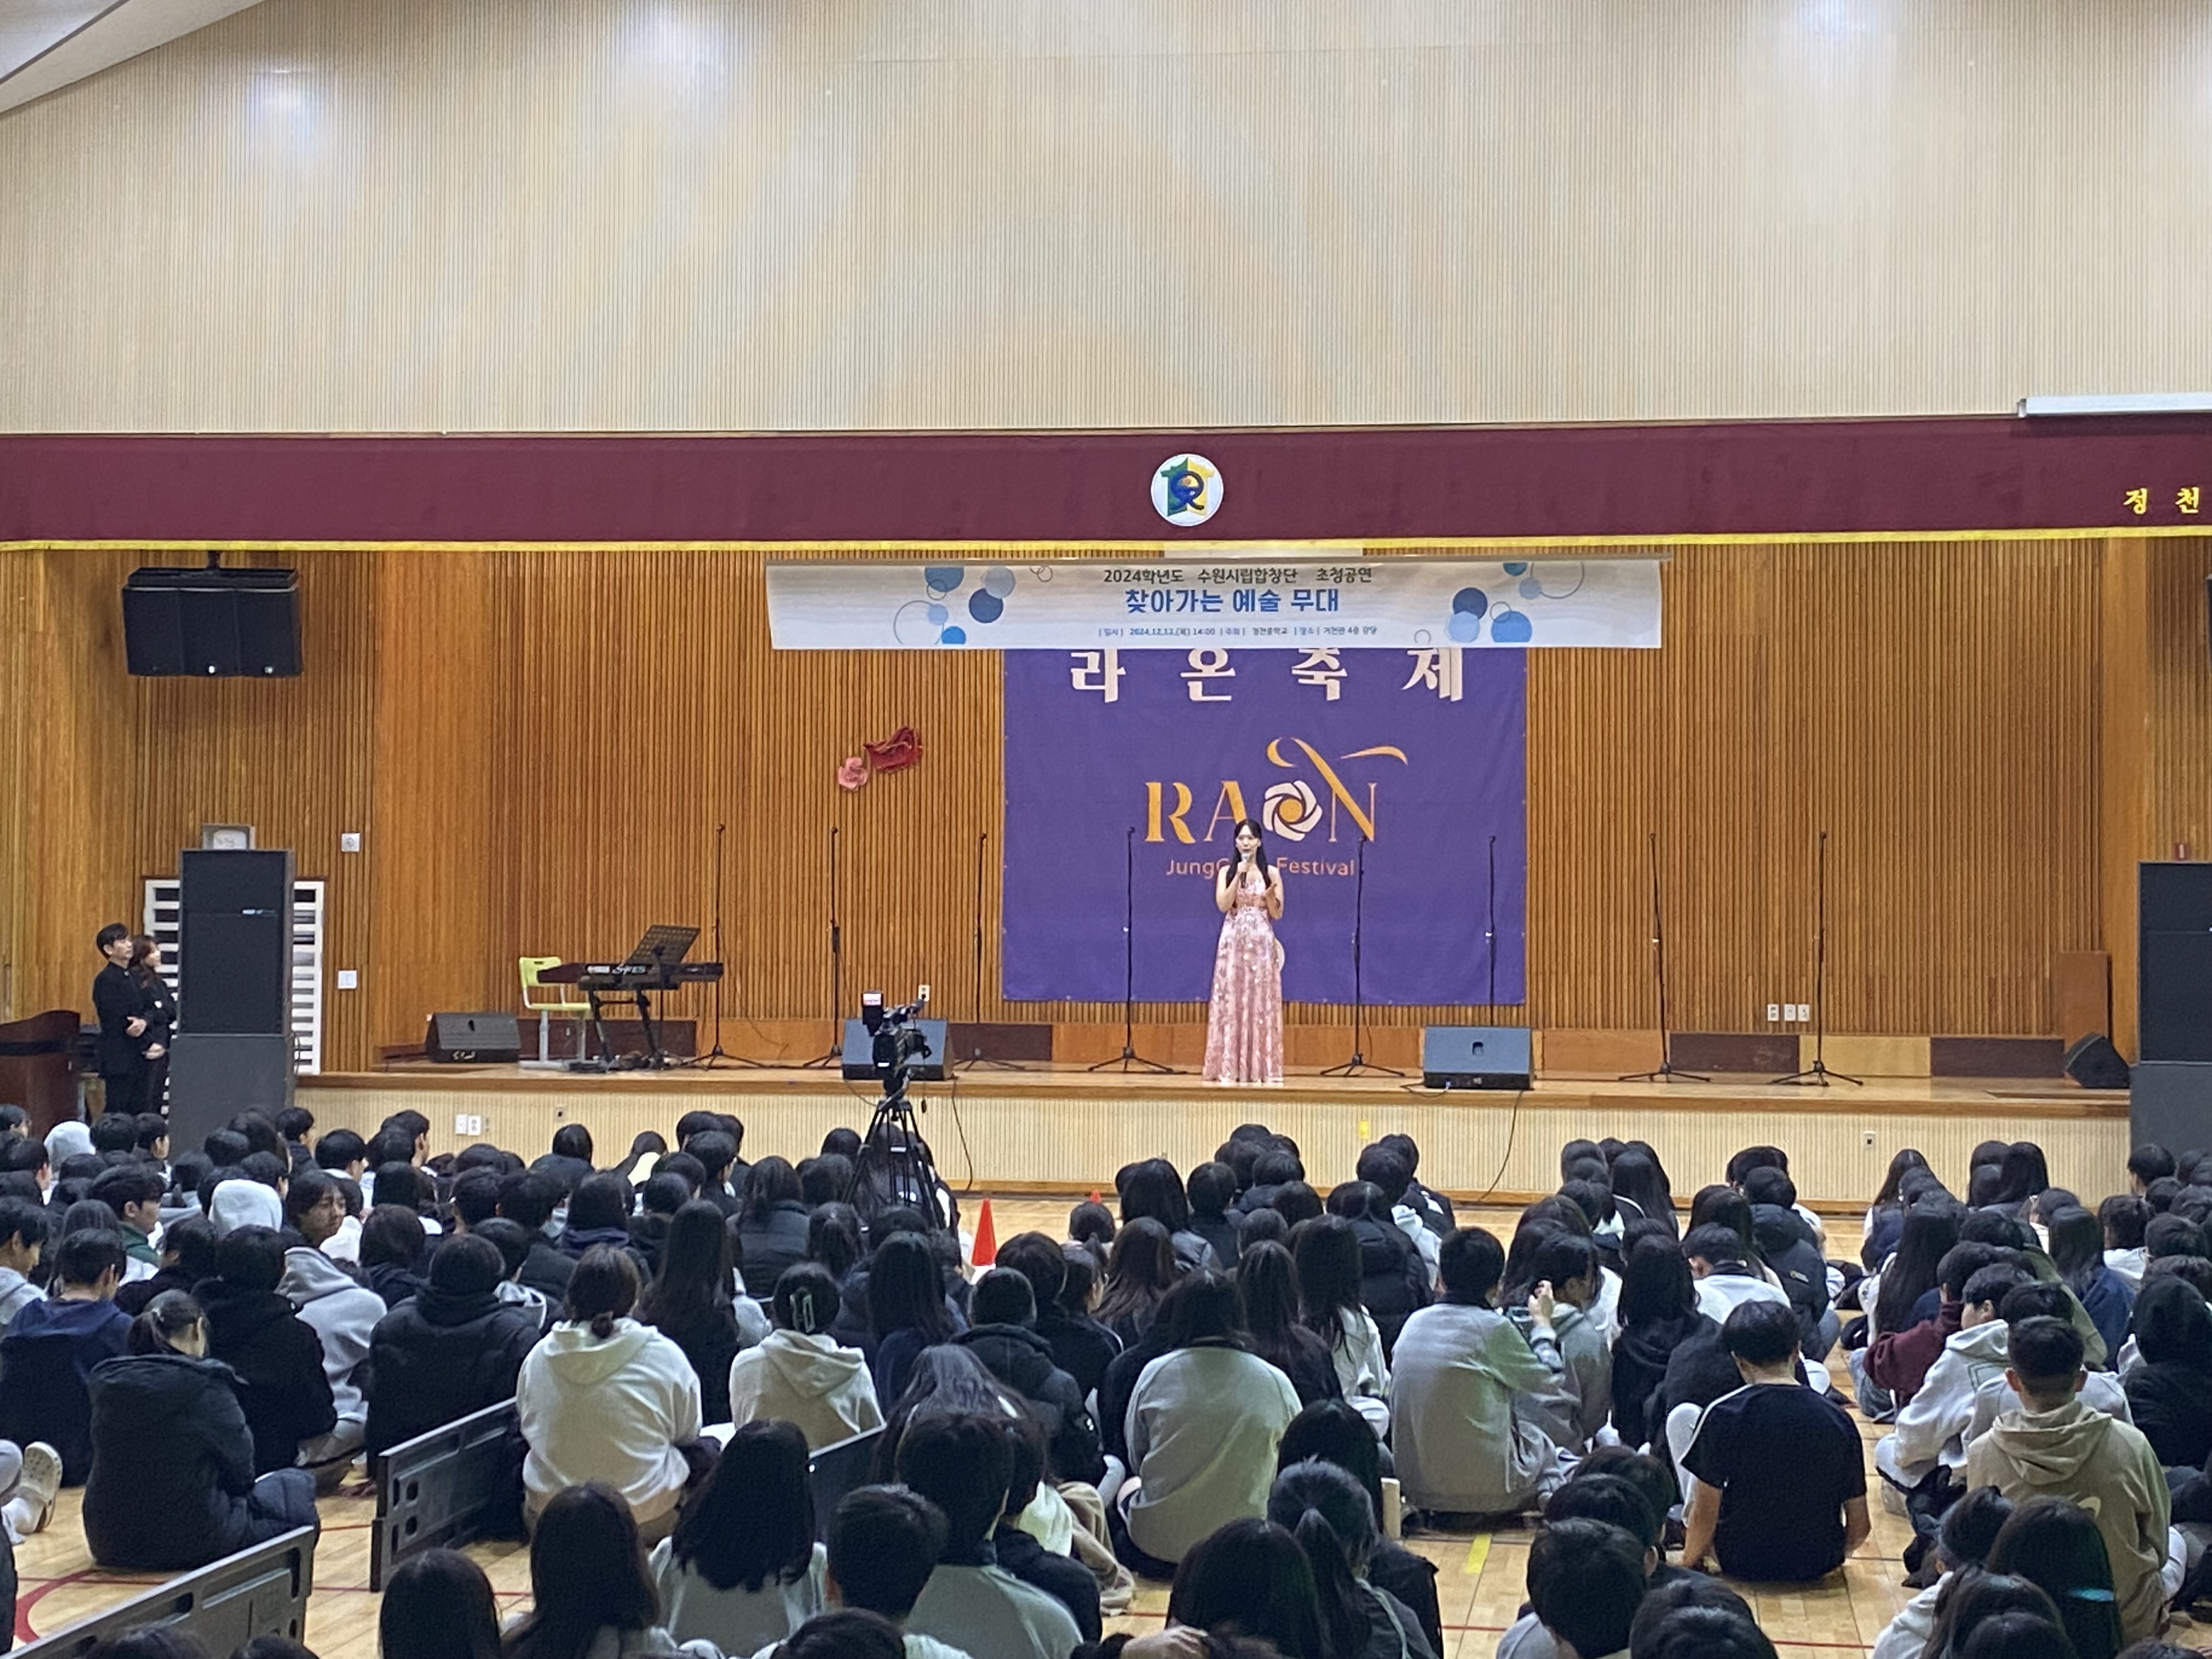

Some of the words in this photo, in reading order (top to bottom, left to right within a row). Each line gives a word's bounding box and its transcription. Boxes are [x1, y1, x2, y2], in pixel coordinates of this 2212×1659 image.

[1104, 569, 1185, 584] 2024학년도
[1197, 568, 1298, 584] 수원시립합창단
[1316, 567, 1373, 583] 초청공연
[1125, 589, 1224, 613] 찾아가는
[1233, 589, 1282, 612] 예술
[1290, 588, 1339, 612] 무대
[1276, 857, 1356, 876] Festival
